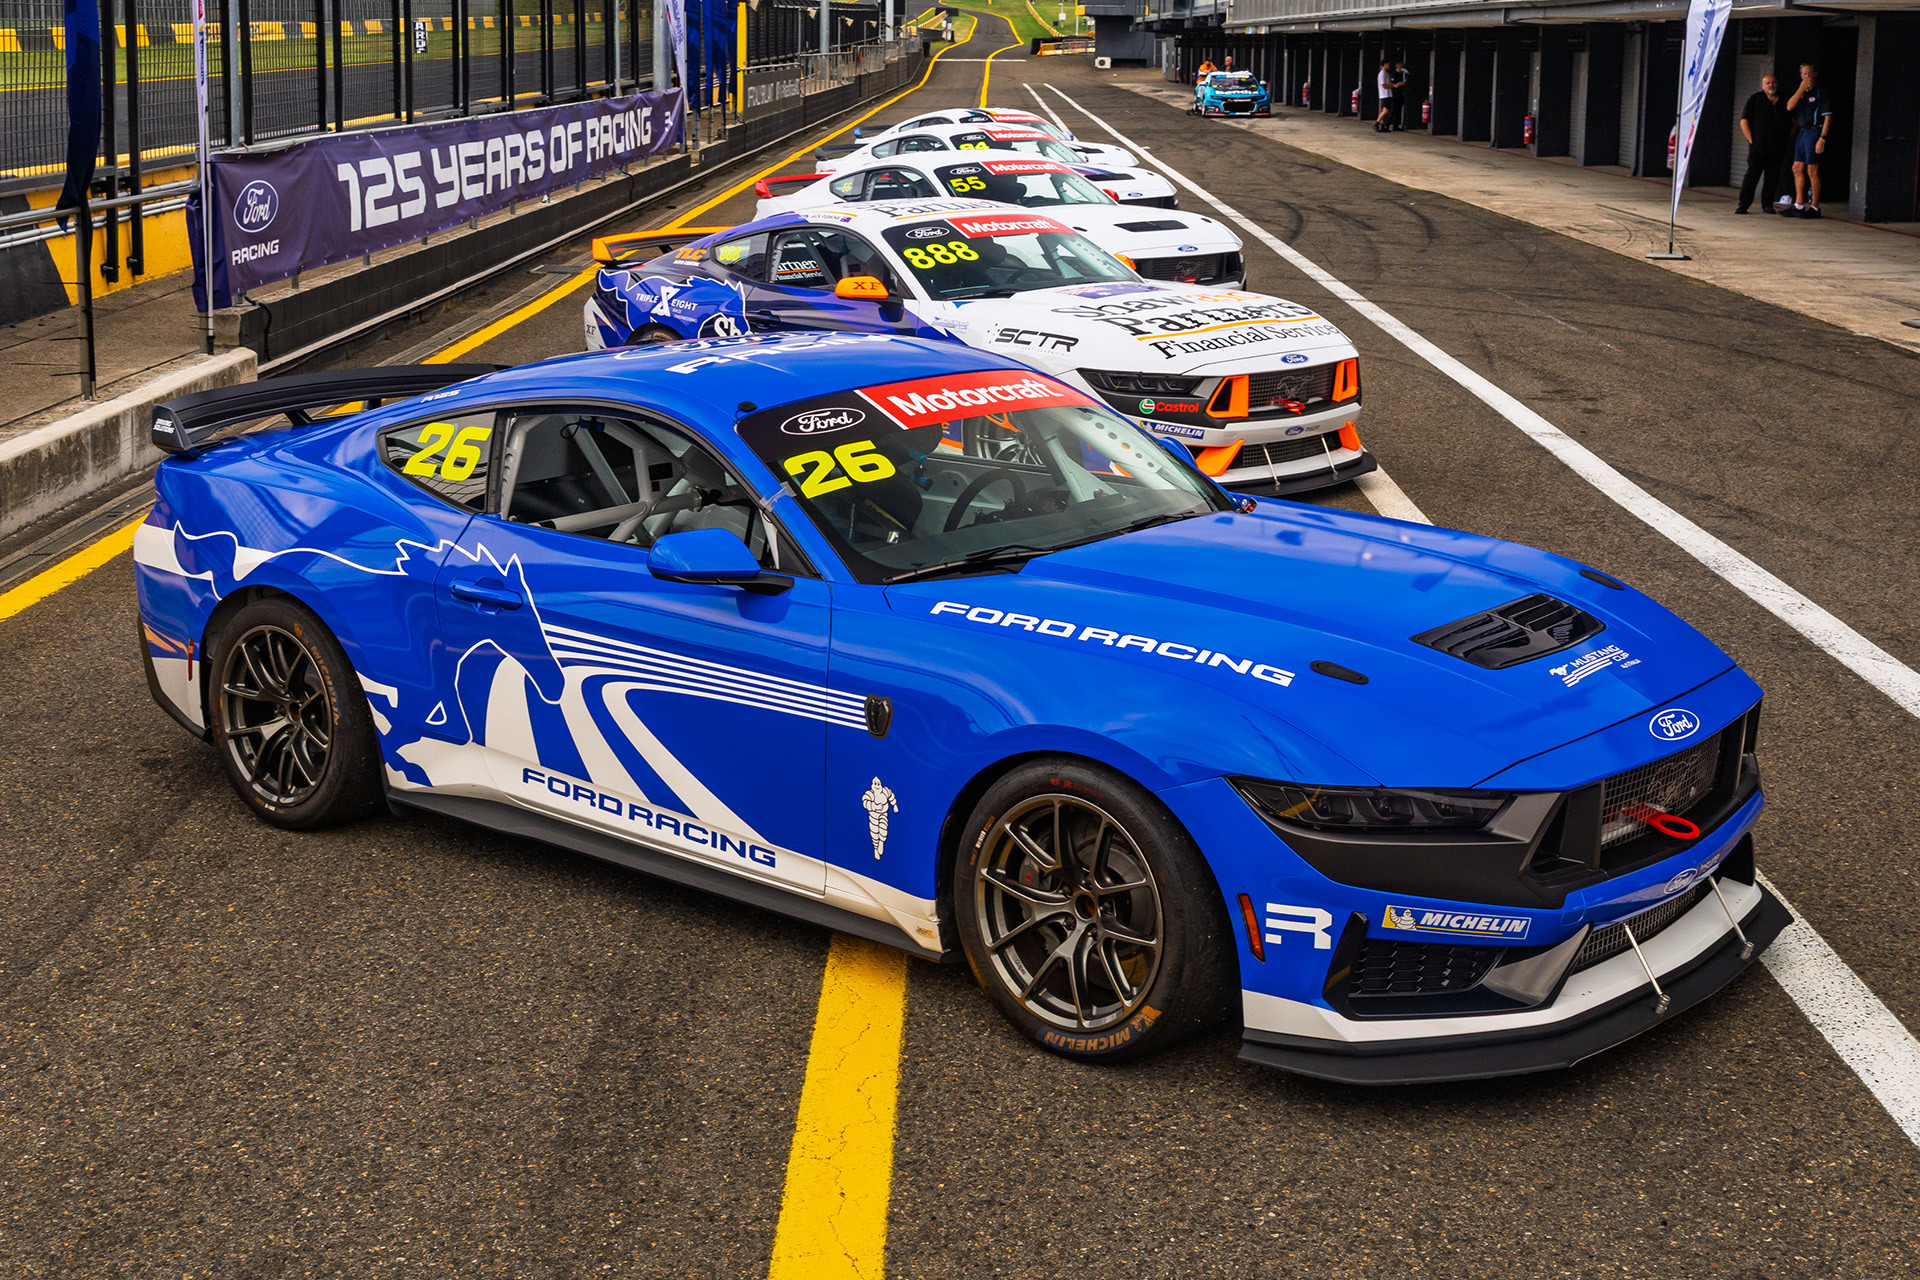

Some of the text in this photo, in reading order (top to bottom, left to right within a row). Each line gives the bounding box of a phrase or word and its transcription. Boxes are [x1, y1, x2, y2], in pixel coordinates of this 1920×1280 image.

[337, 106, 653, 232] 125 YEARS OF RACING
[991, 163, 1062, 173] Motorcraft
[950, 176, 987, 193] 55
[242, 187, 271, 225] Ford
[961, 218, 1060, 234] Motorcraft
[232, 239, 280, 266] RACING
[676, 247, 707, 260] TLC
[719, 245, 742, 261] 888
[903, 241, 980, 269] 888
[853, 281, 882, 291] XF
[635, 293, 698, 312] TRIPLE EIGHT
[1050, 295, 1191, 318] Shaw
[1095, 301, 1314, 336] Partners
[994, 328, 1079, 352] SCTR
[1149, 326, 1271, 360] Financial
[886, 378, 1063, 416] Motorcraft
[1155, 402, 1199, 413] Castrol
[798, 410, 853, 432] Ford
[1154, 423, 1204, 437] MICHELIN
[403, 422, 492, 482] 26
[783, 439, 896, 498] 26
[931, 600, 1296, 687] FORD RACING
[1569, 644, 1620, 668] MUSTANG
[1612, 651, 1629, 662] CUP
[522, 767, 778, 869] FORD RACING
[1420, 912, 1527, 933] MICHELIN
[1043, 1028, 1131, 1051] MICHELIN
